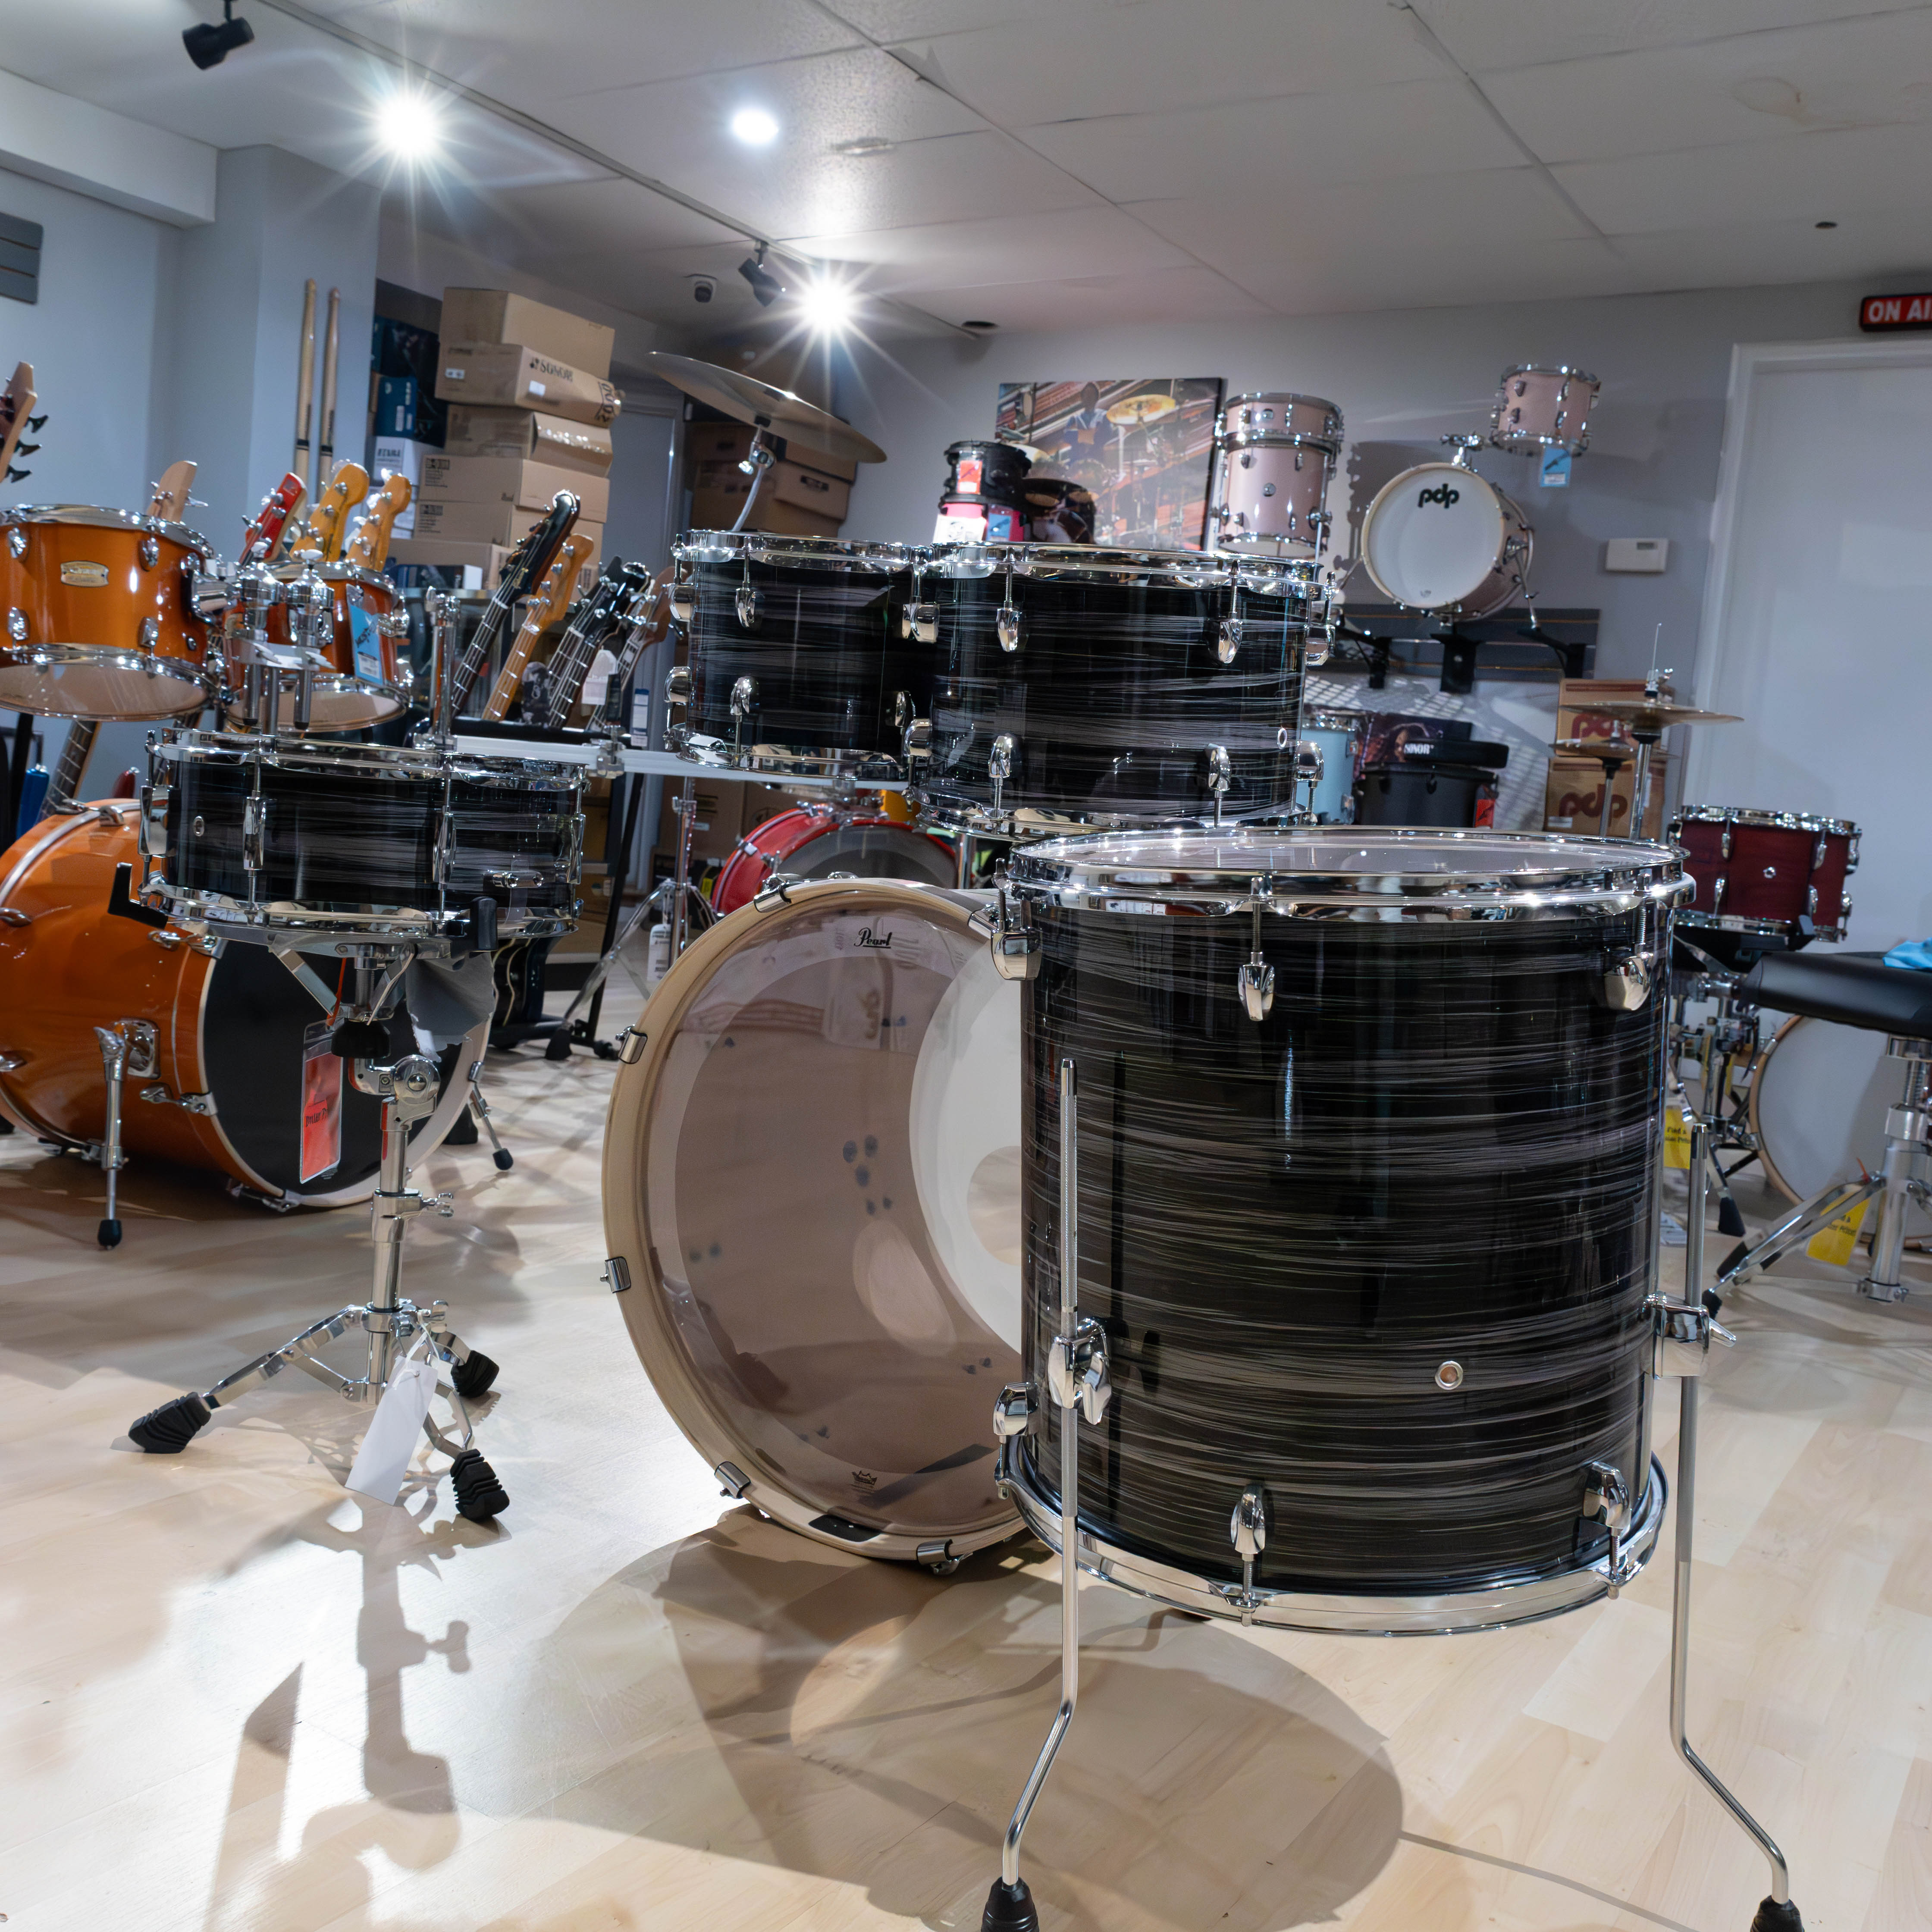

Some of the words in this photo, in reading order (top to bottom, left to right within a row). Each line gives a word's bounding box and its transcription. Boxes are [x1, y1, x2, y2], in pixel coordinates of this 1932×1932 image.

[1868, 300, 1901, 323] ON
[1906, 298, 1932, 320] AI
[1418, 483, 1460, 508] pdp
[854, 927, 892, 948] Pearl
